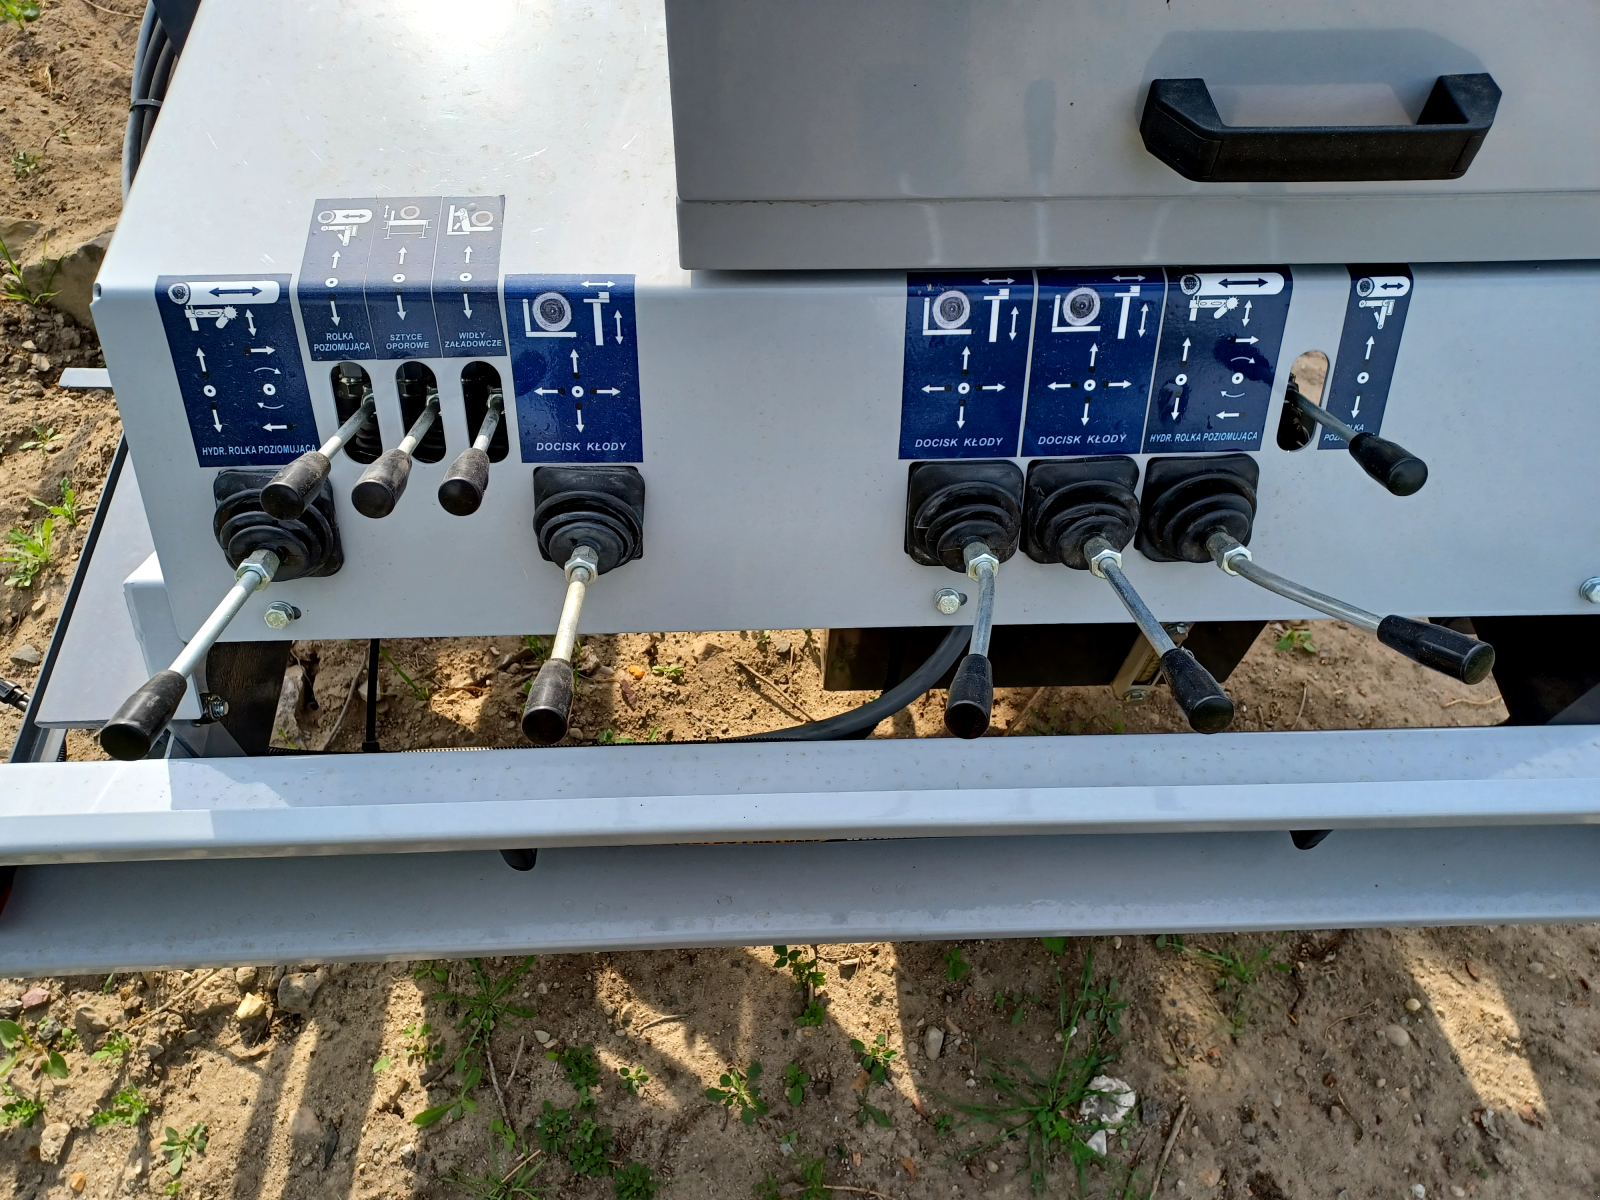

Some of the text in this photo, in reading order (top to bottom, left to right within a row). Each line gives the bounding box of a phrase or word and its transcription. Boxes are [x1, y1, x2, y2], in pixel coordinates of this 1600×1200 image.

[326, 332, 354, 341] ROLKA
[390, 333, 423, 341] SZTYCE
[458, 331, 486, 339] WIDŁY
[313, 342, 371, 352] POZIOMUJĄCA
[385, 341, 430, 350] OPOROWE
[444, 339, 502, 348] ZAŁADOWCZE
[1037, 433, 1127, 445] DOCISK KŁODY
[1149, 431, 1258, 443] HYDR. ROLKA POZIOMUJĄCA
[536, 442, 627, 451] DOCISK KŁODY
[914, 437, 1004, 448] DOCISK KŁODY
[202, 446, 227, 456] HYDR.
[228, 445, 257, 455] ROLKA
